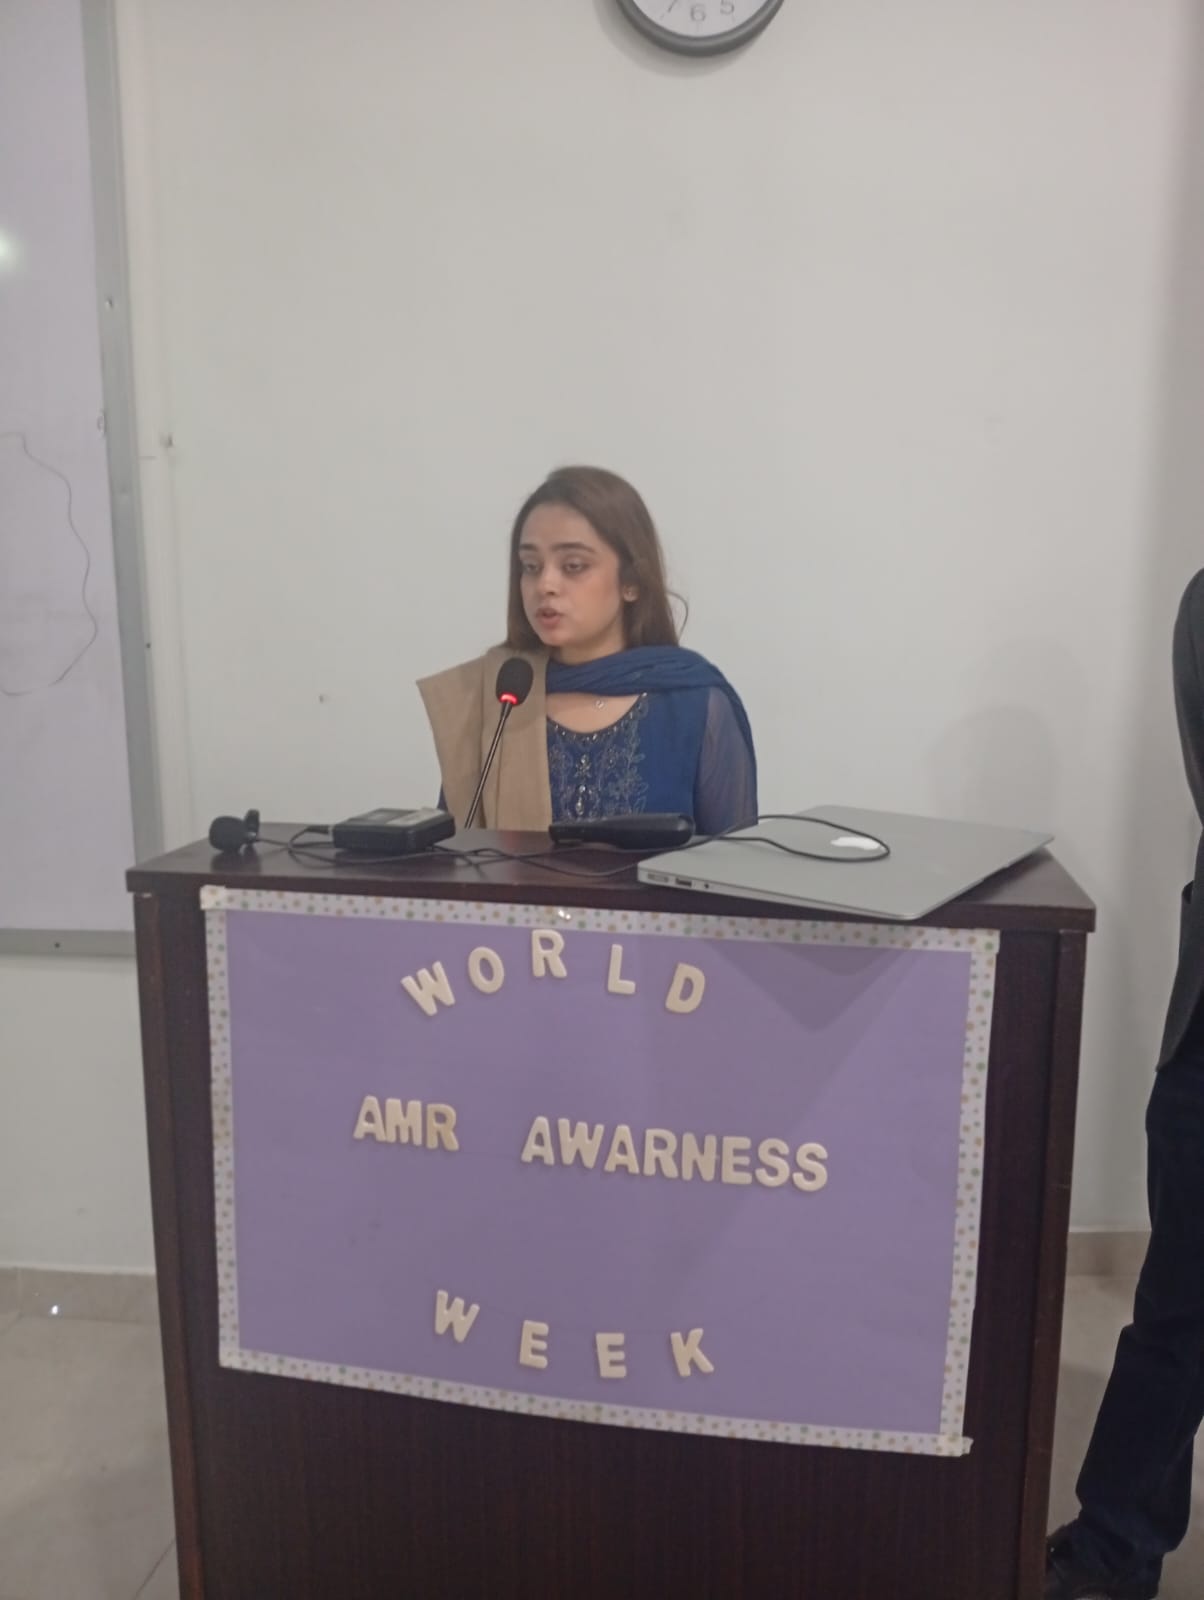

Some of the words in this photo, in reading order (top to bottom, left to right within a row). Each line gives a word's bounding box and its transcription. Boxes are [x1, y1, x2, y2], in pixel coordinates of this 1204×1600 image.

[689, 3, 707, 22] 6
[720, 0, 735, 15] 5
[400, 928, 707, 1017] WORLD
[353, 1094, 460, 1151] AMR
[520, 1115, 829, 1193] AWARNESS
[434, 1289, 715, 1379] WEEK
